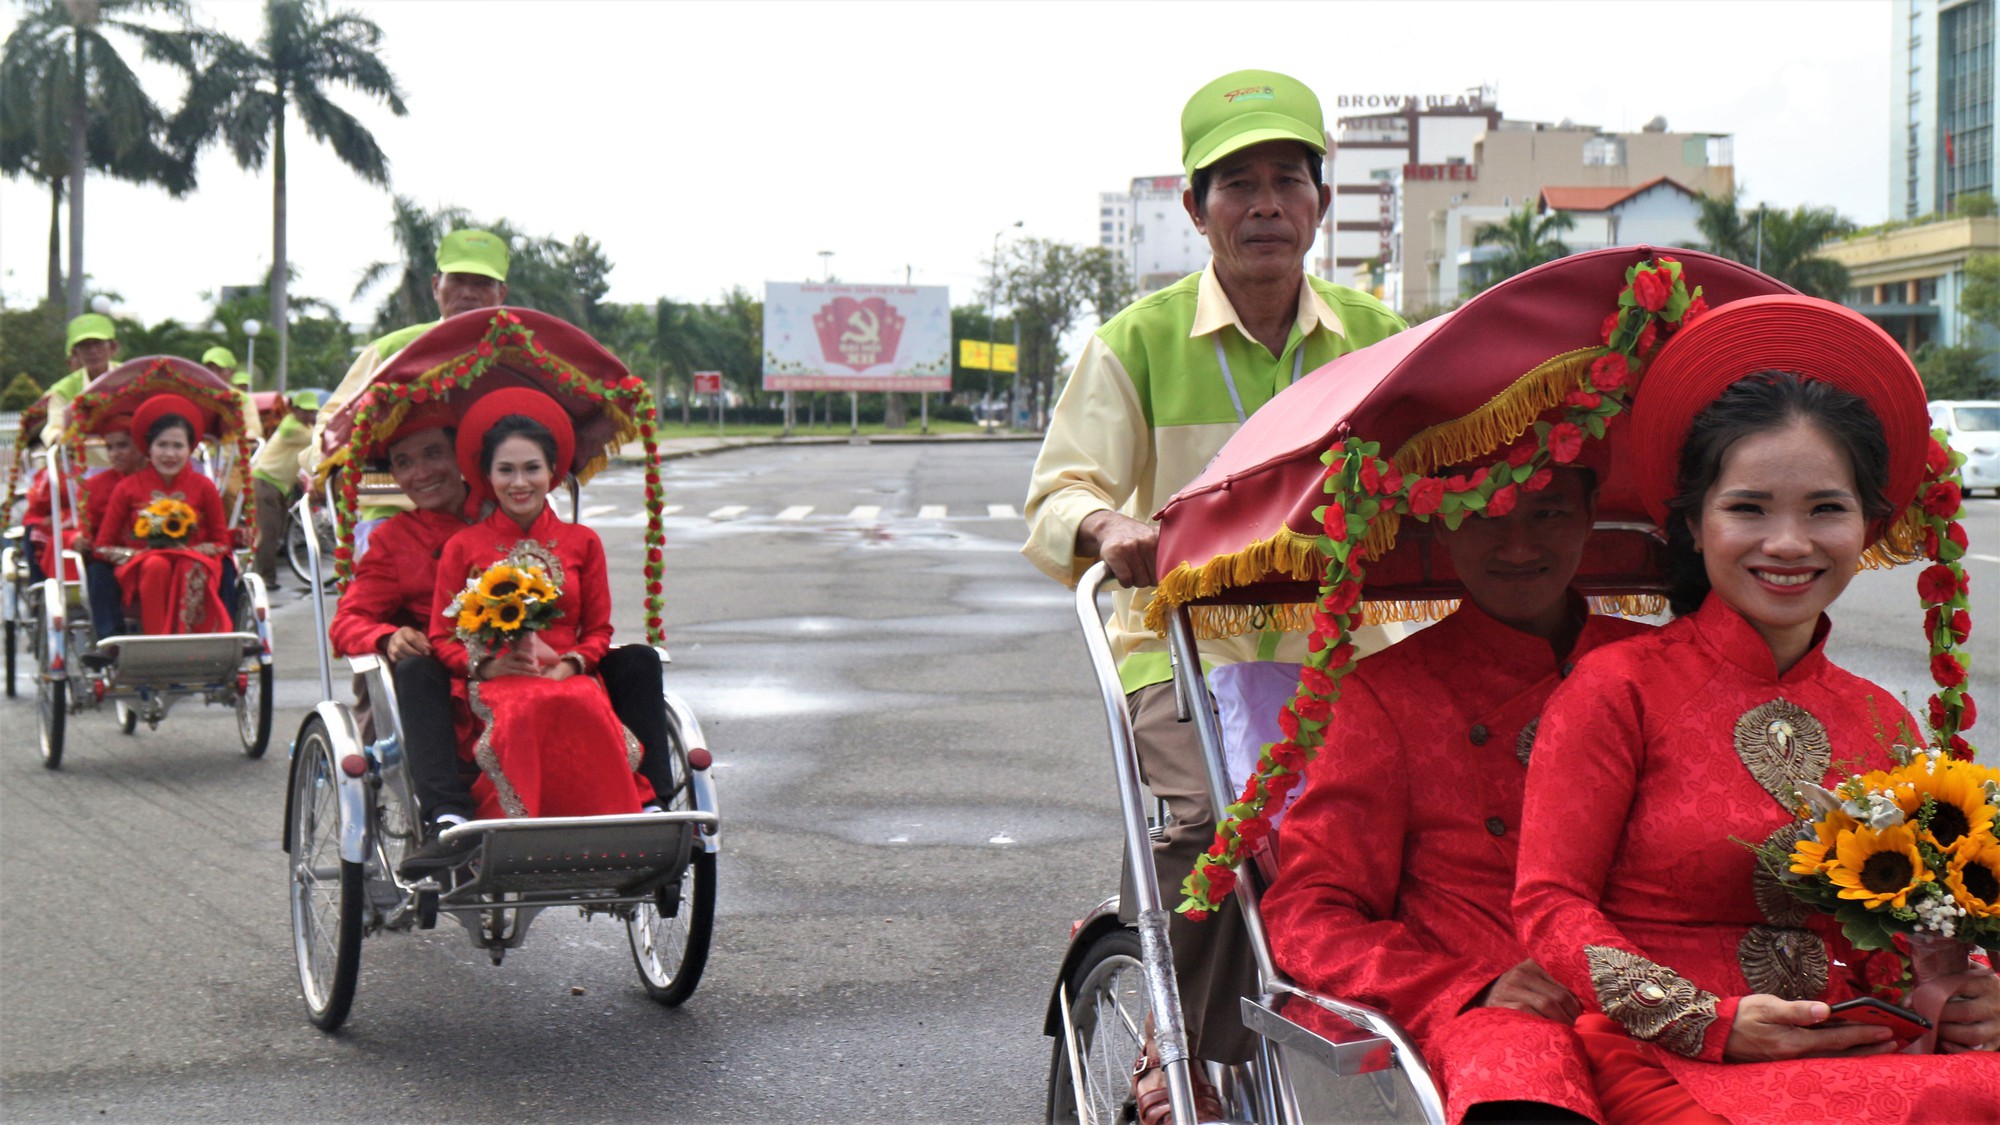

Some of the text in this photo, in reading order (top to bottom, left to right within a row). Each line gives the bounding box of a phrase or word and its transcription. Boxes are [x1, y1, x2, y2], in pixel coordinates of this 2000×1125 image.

[1337, 94, 1482, 109] BROWN BEAN
[1403, 164, 1478, 181] HOTEL
